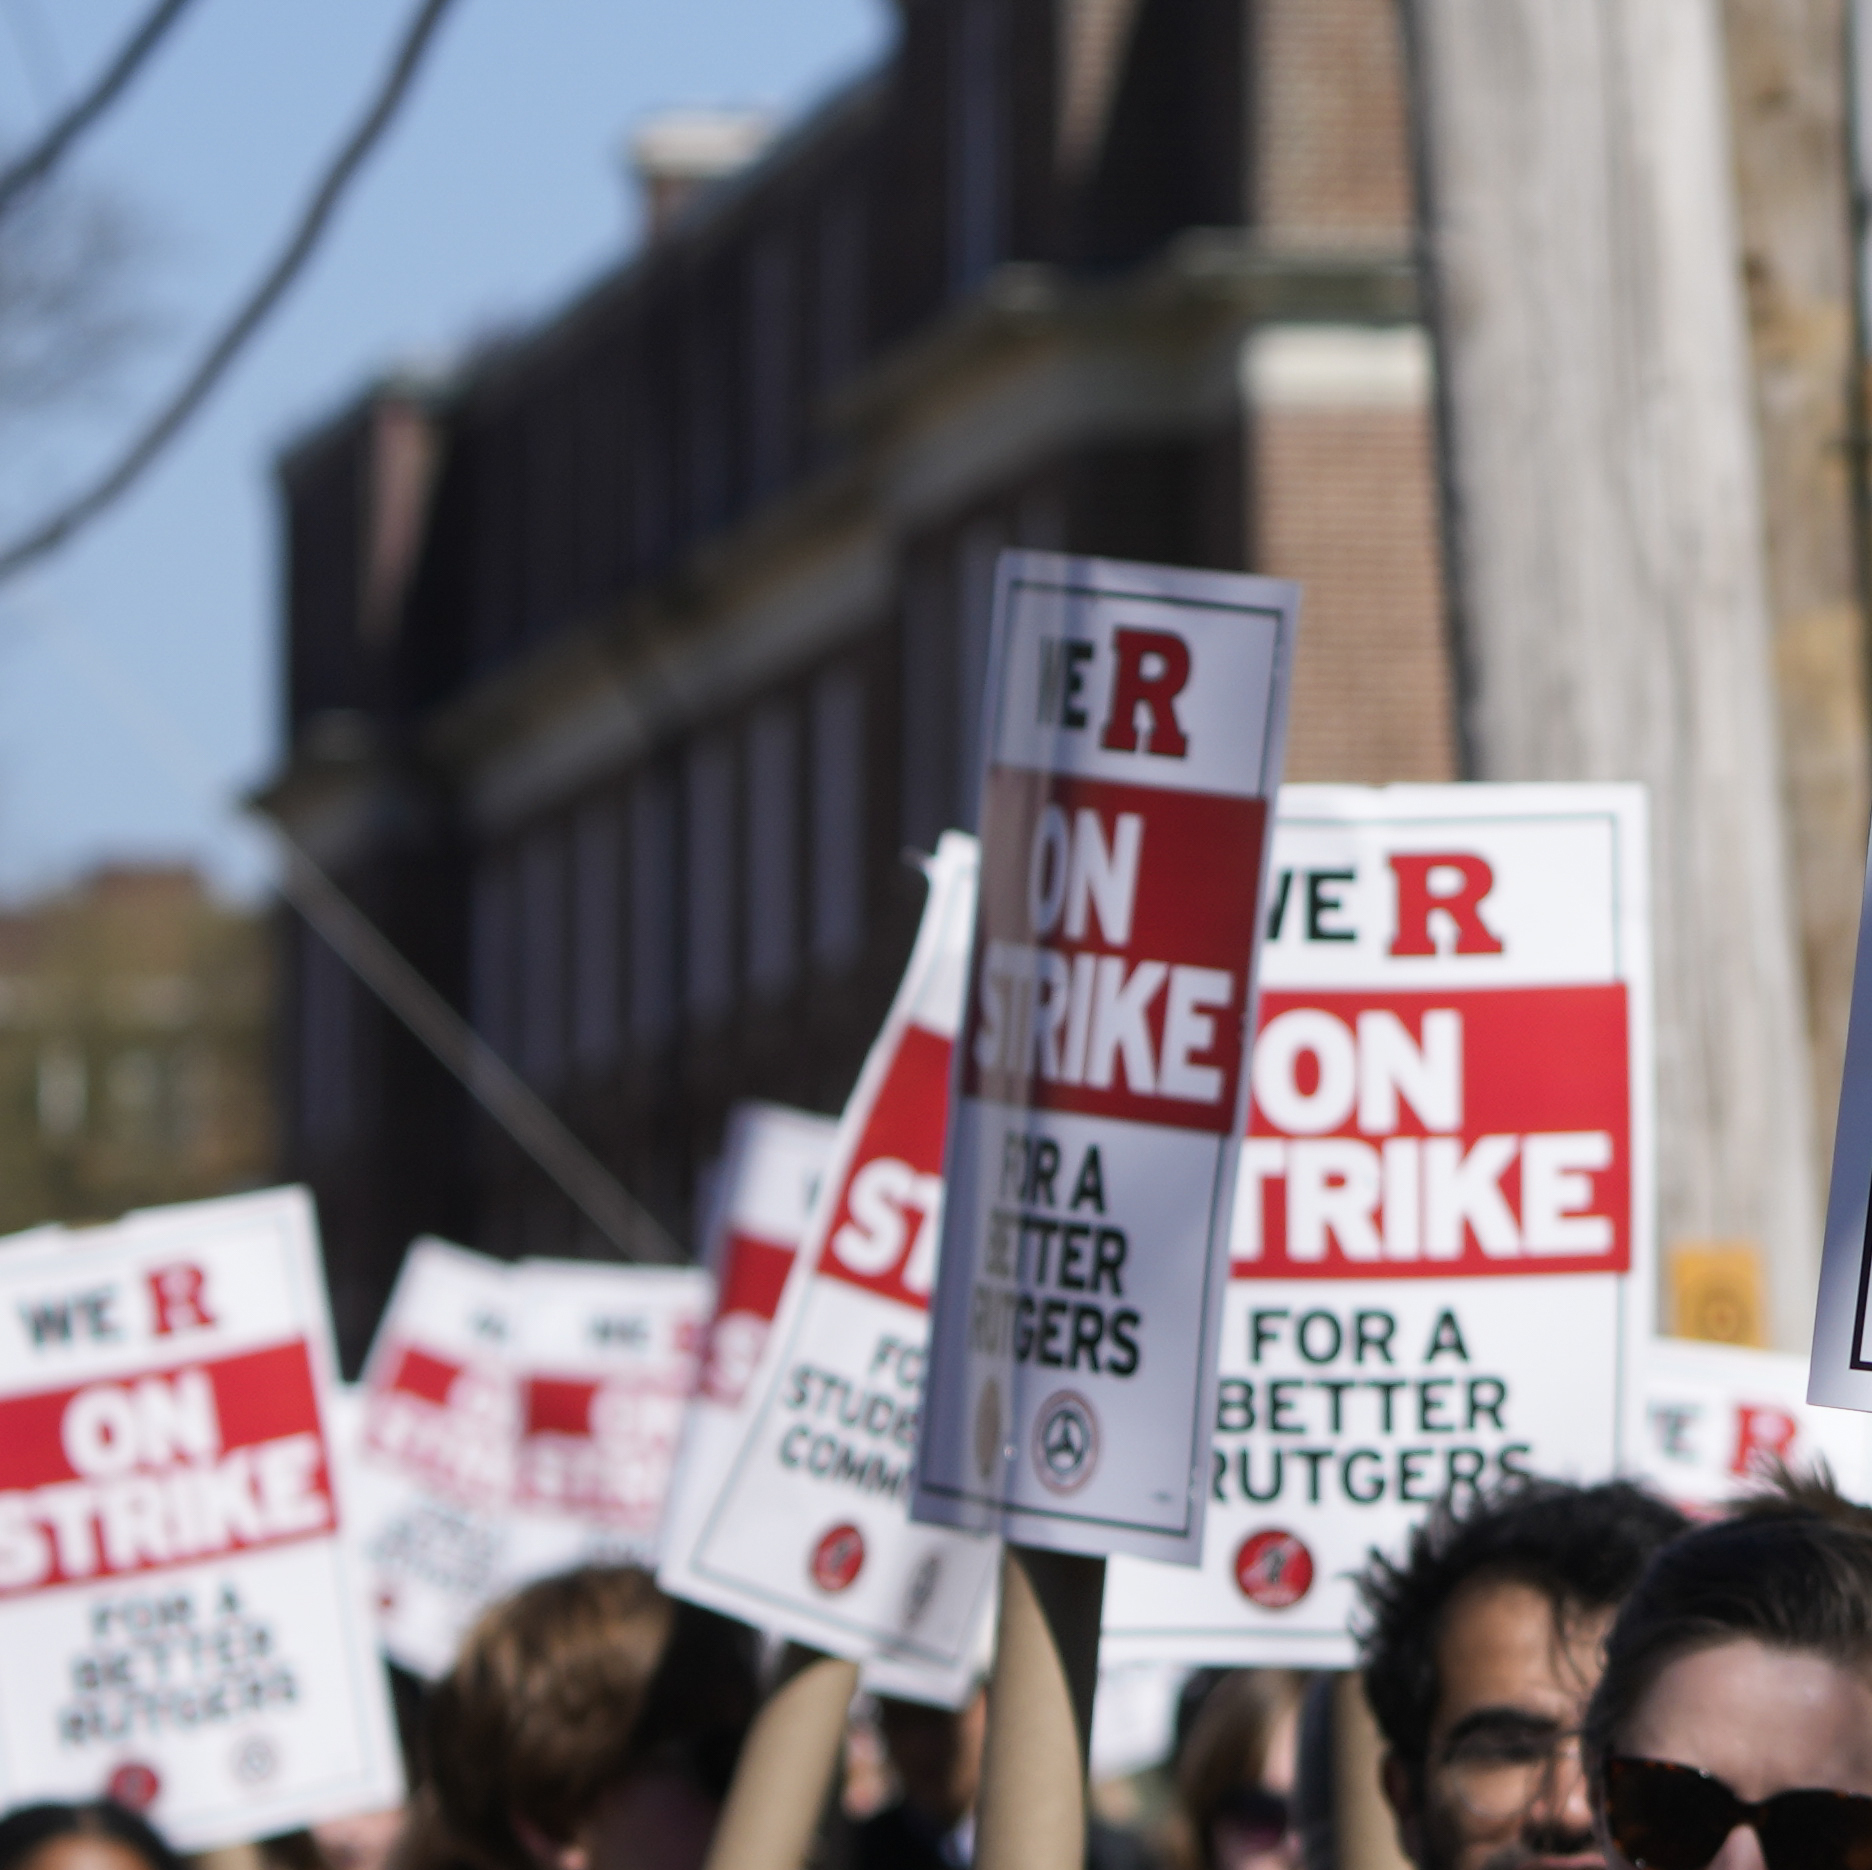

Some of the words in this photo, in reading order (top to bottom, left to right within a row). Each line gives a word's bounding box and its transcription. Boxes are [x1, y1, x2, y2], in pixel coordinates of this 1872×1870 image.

[1038, 635, 1093, 730] E
[1102, 627, 1190, 758] R
[1030, 803, 1144, 948] ON
[1386, 850, 1504, 958] R
[1252, 1007, 1463, 1135] ON
[1071, 1143, 1107, 1213] A
[1250, 1307, 1397, 1366] FOR
[1425, 1305, 1471, 1365] A
[63, 1363, 220, 1478] ON
[1215, 1376, 1508, 1435] BETTER
[0, 1432, 328, 1587] STRIKE
